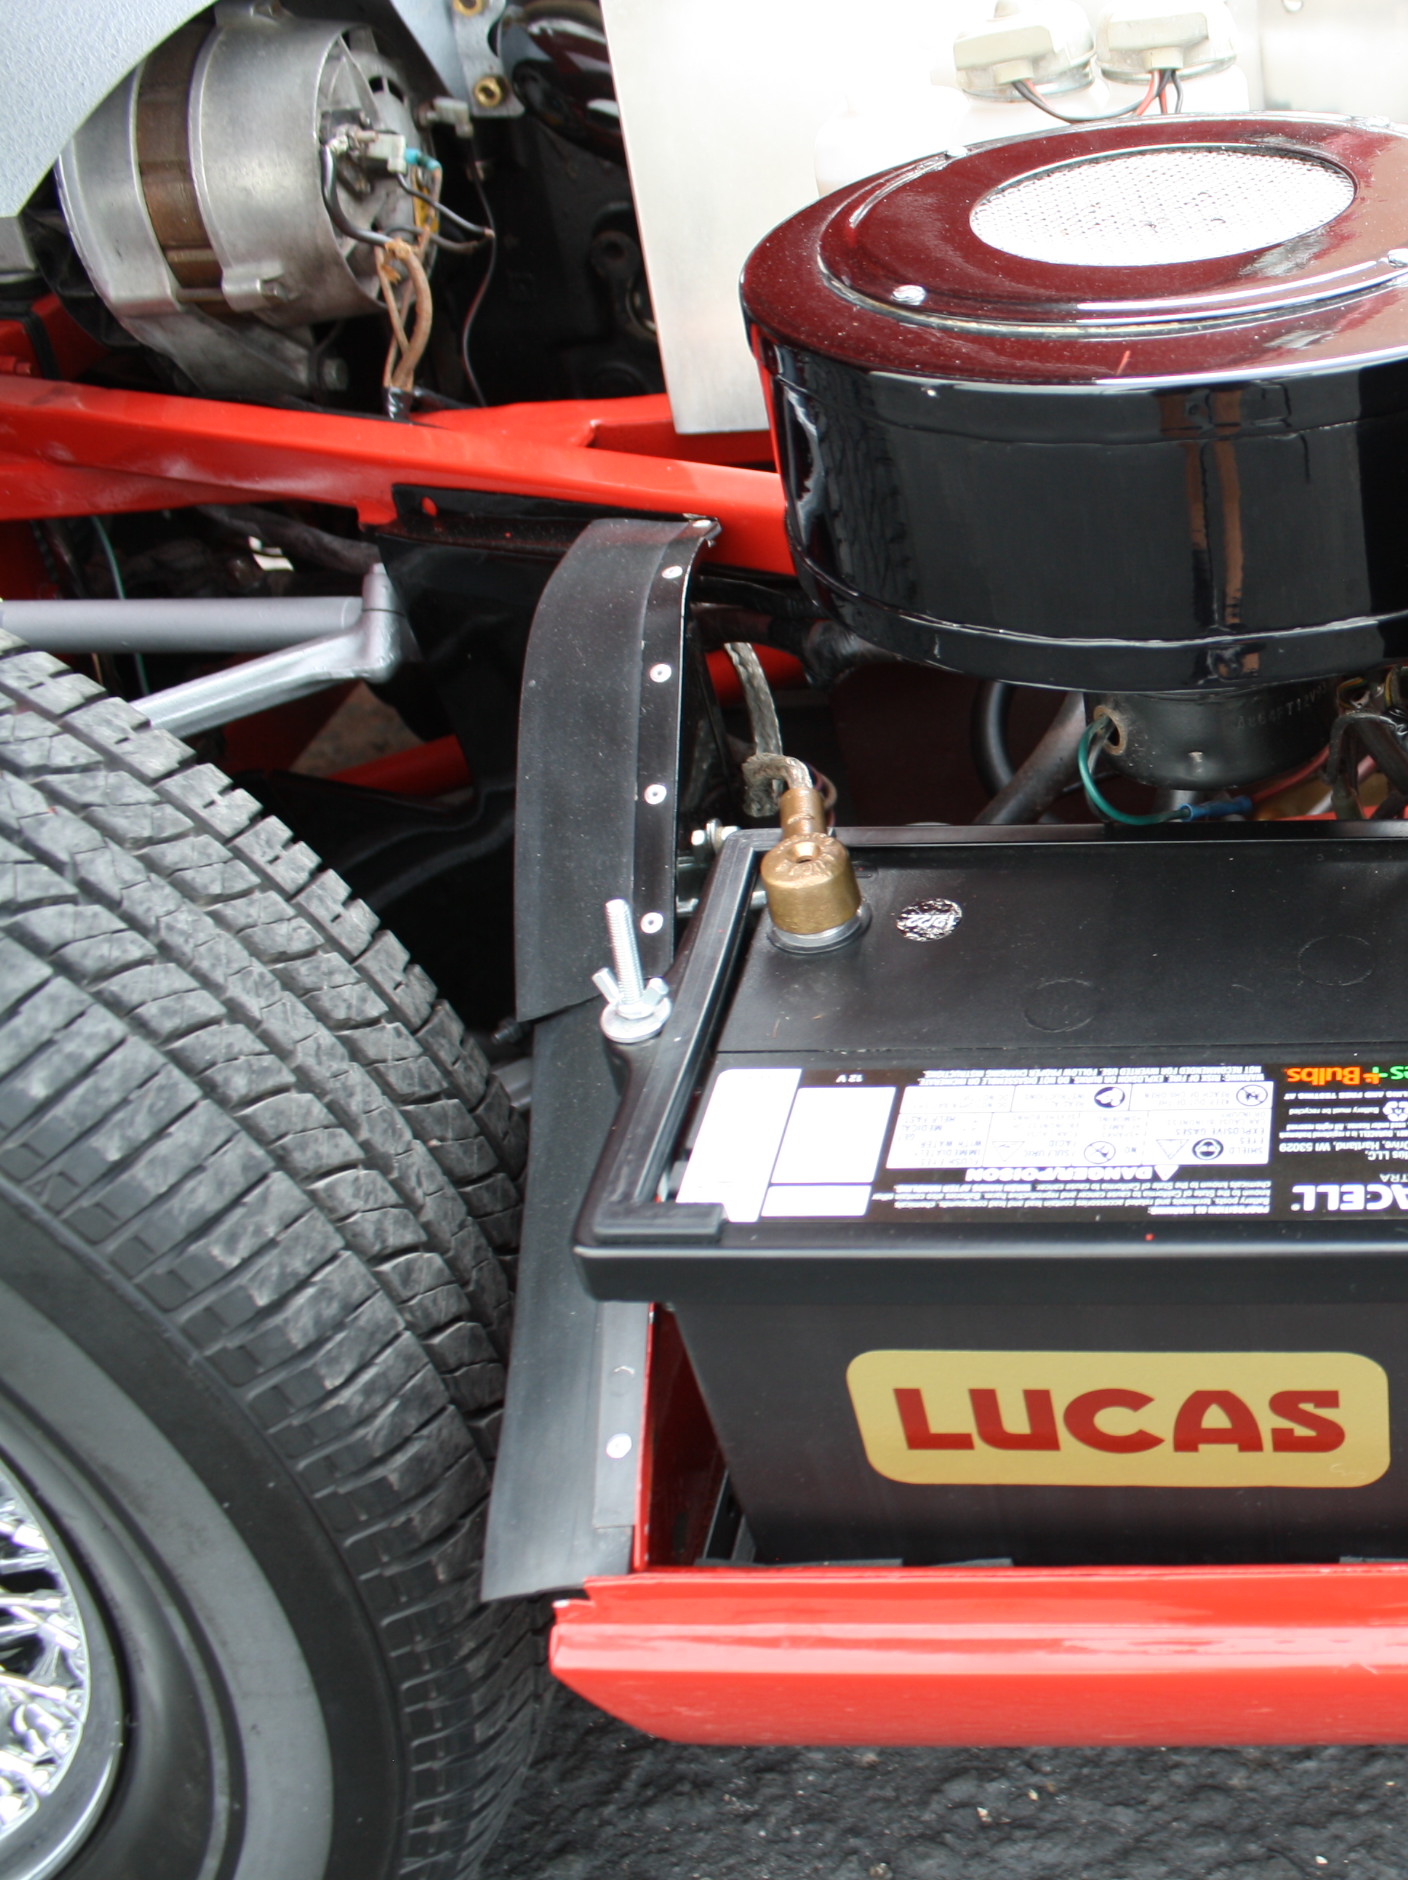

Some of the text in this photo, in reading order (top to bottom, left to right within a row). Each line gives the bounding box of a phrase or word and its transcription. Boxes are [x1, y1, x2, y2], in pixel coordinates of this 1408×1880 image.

[835, 1074, 862, 1083] 12 V
[1286, 1067, 1360, 1085] Bulbs
[1212, 1128, 1264, 1136] EXPLOSIVE
[1279, 1142, 1313, 1153] 53029
[1315, 1142, 1331, 1152] WI
[892, 1387, 1346, 1454] LUCAS
